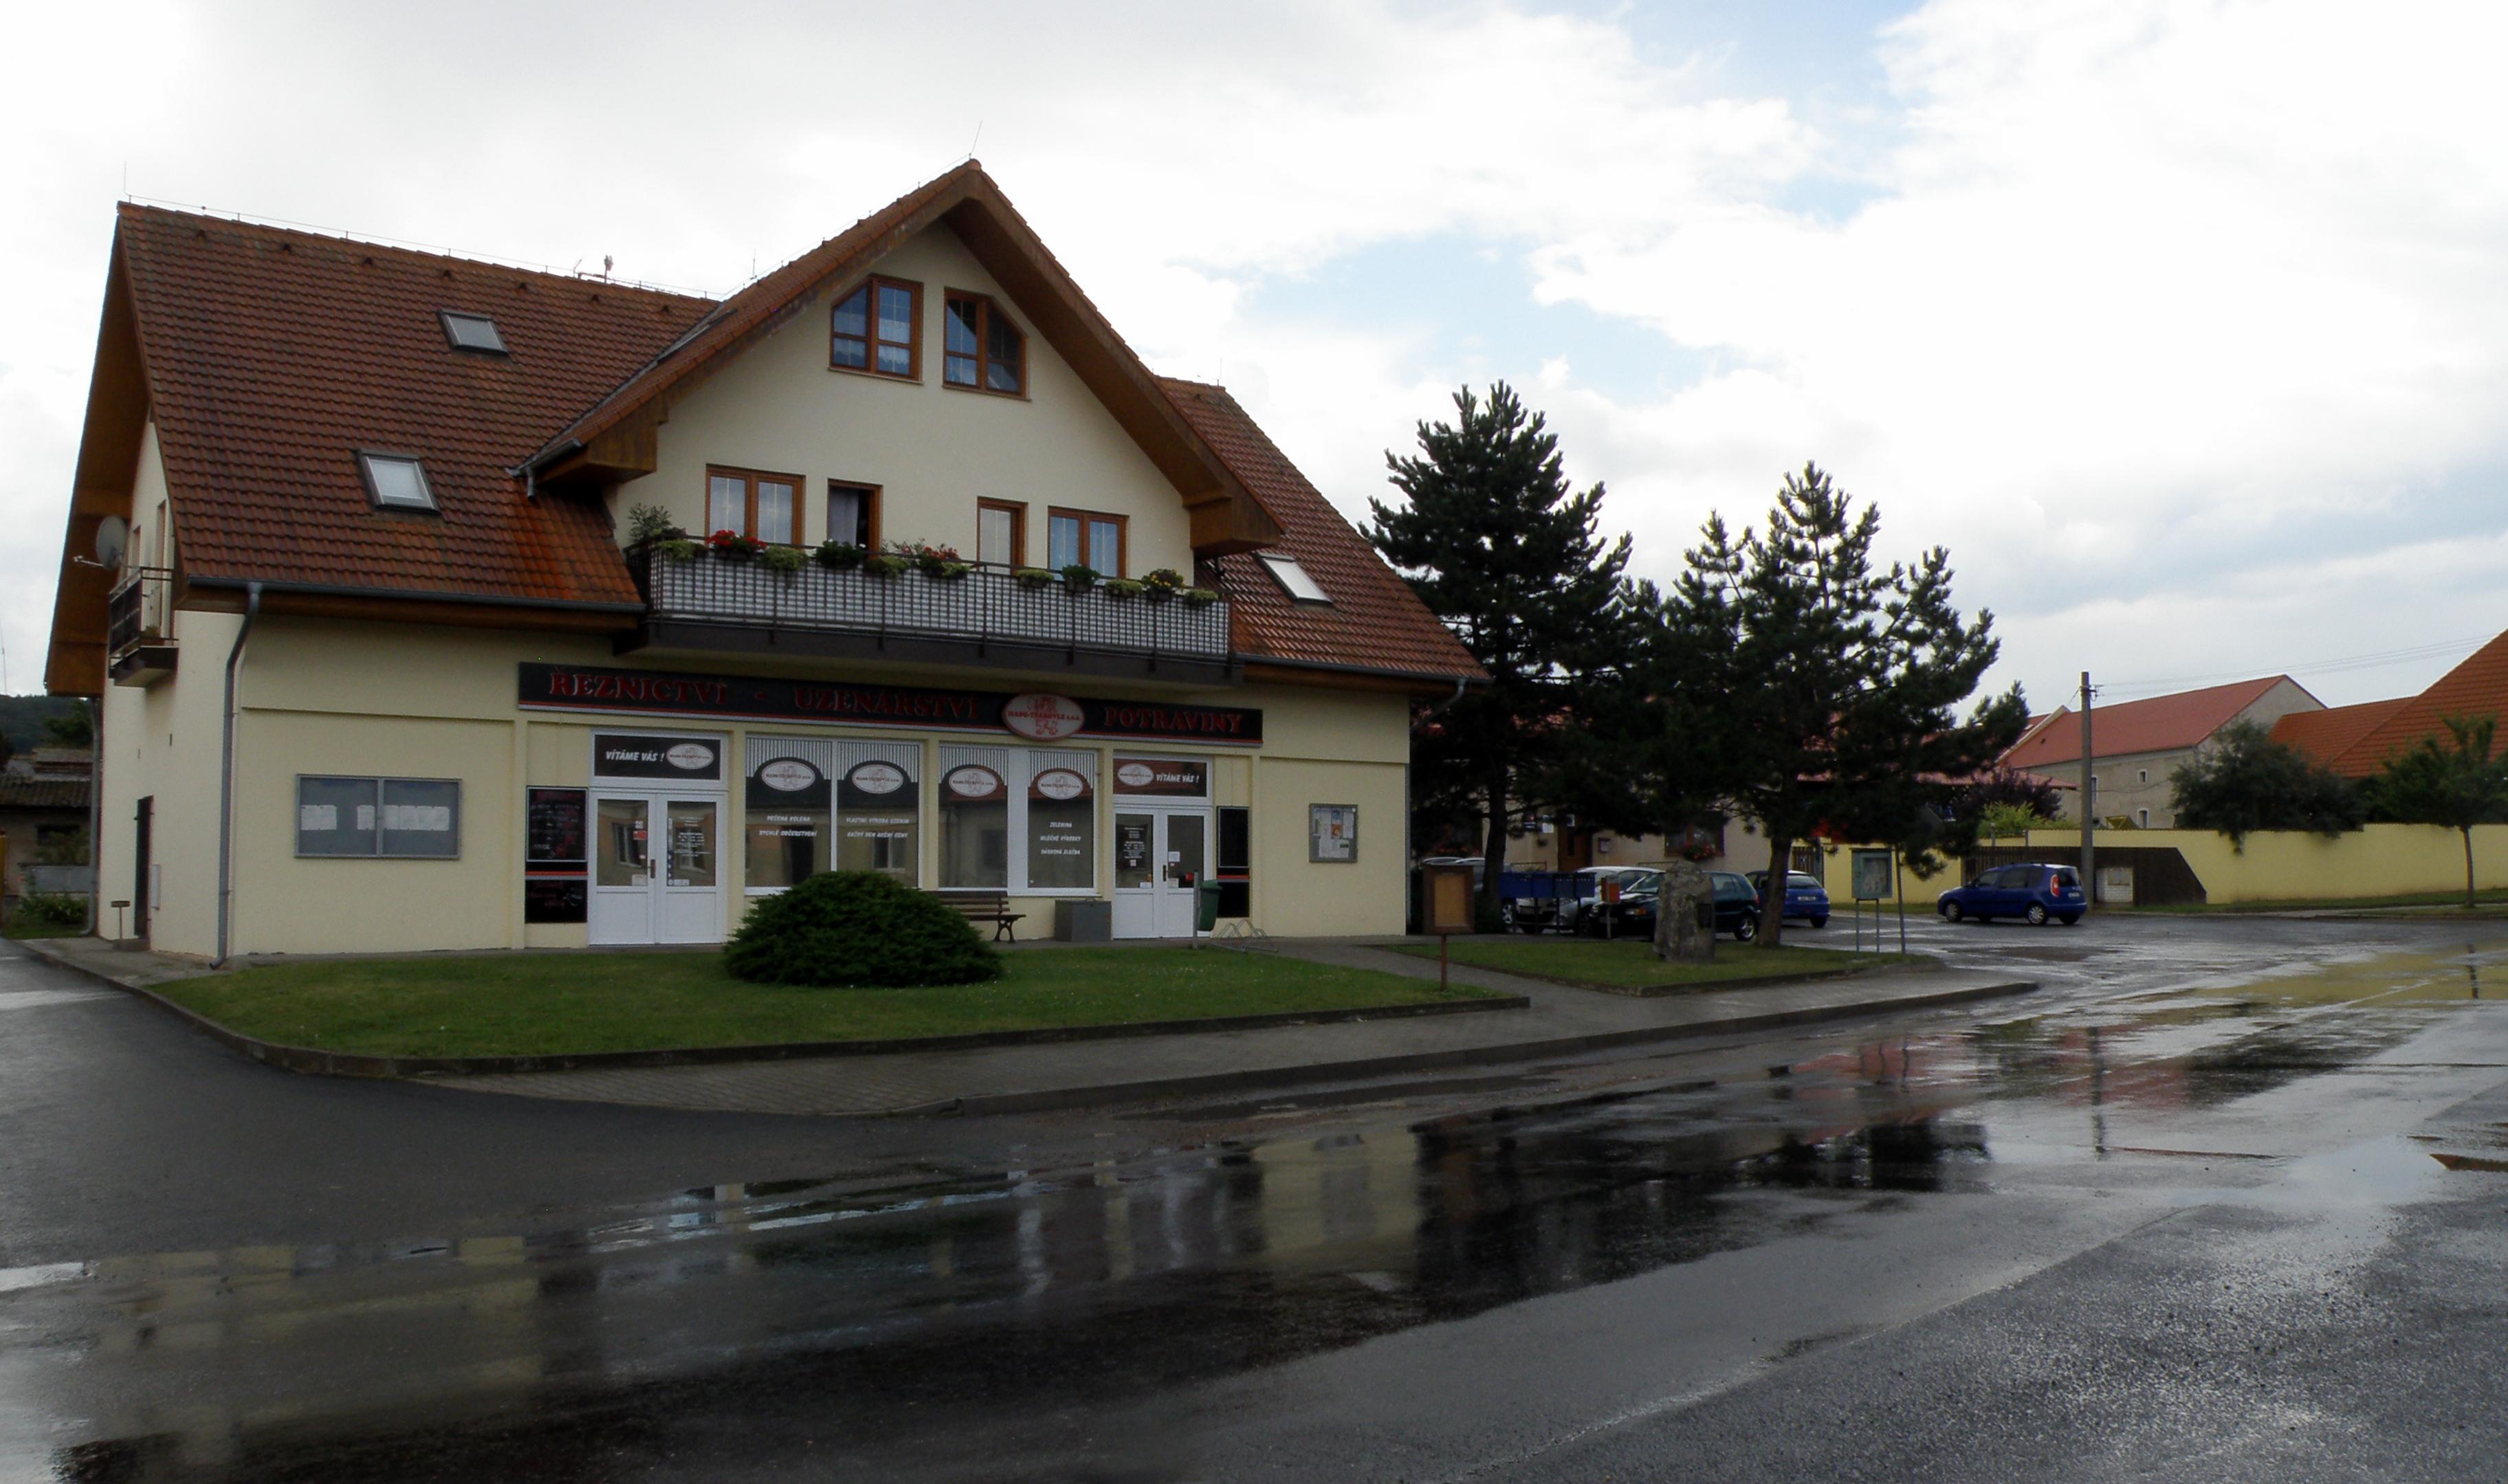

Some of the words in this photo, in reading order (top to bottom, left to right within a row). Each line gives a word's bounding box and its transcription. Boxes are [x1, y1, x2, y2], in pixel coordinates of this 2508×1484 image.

[549, 666, 727, 705] ŘEZNICTVÍ
[794, 687, 978, 719] UZENÁŘSTVÍ
[1102, 705, 1244, 735] POTRAVINY
[606, 749, 640, 762] VÍTÁME
[641, 750, 659, 762] VÁS
[1156, 771, 1181, 783] VÍTÁME
[1182, 773, 1195, 784] VÁS
